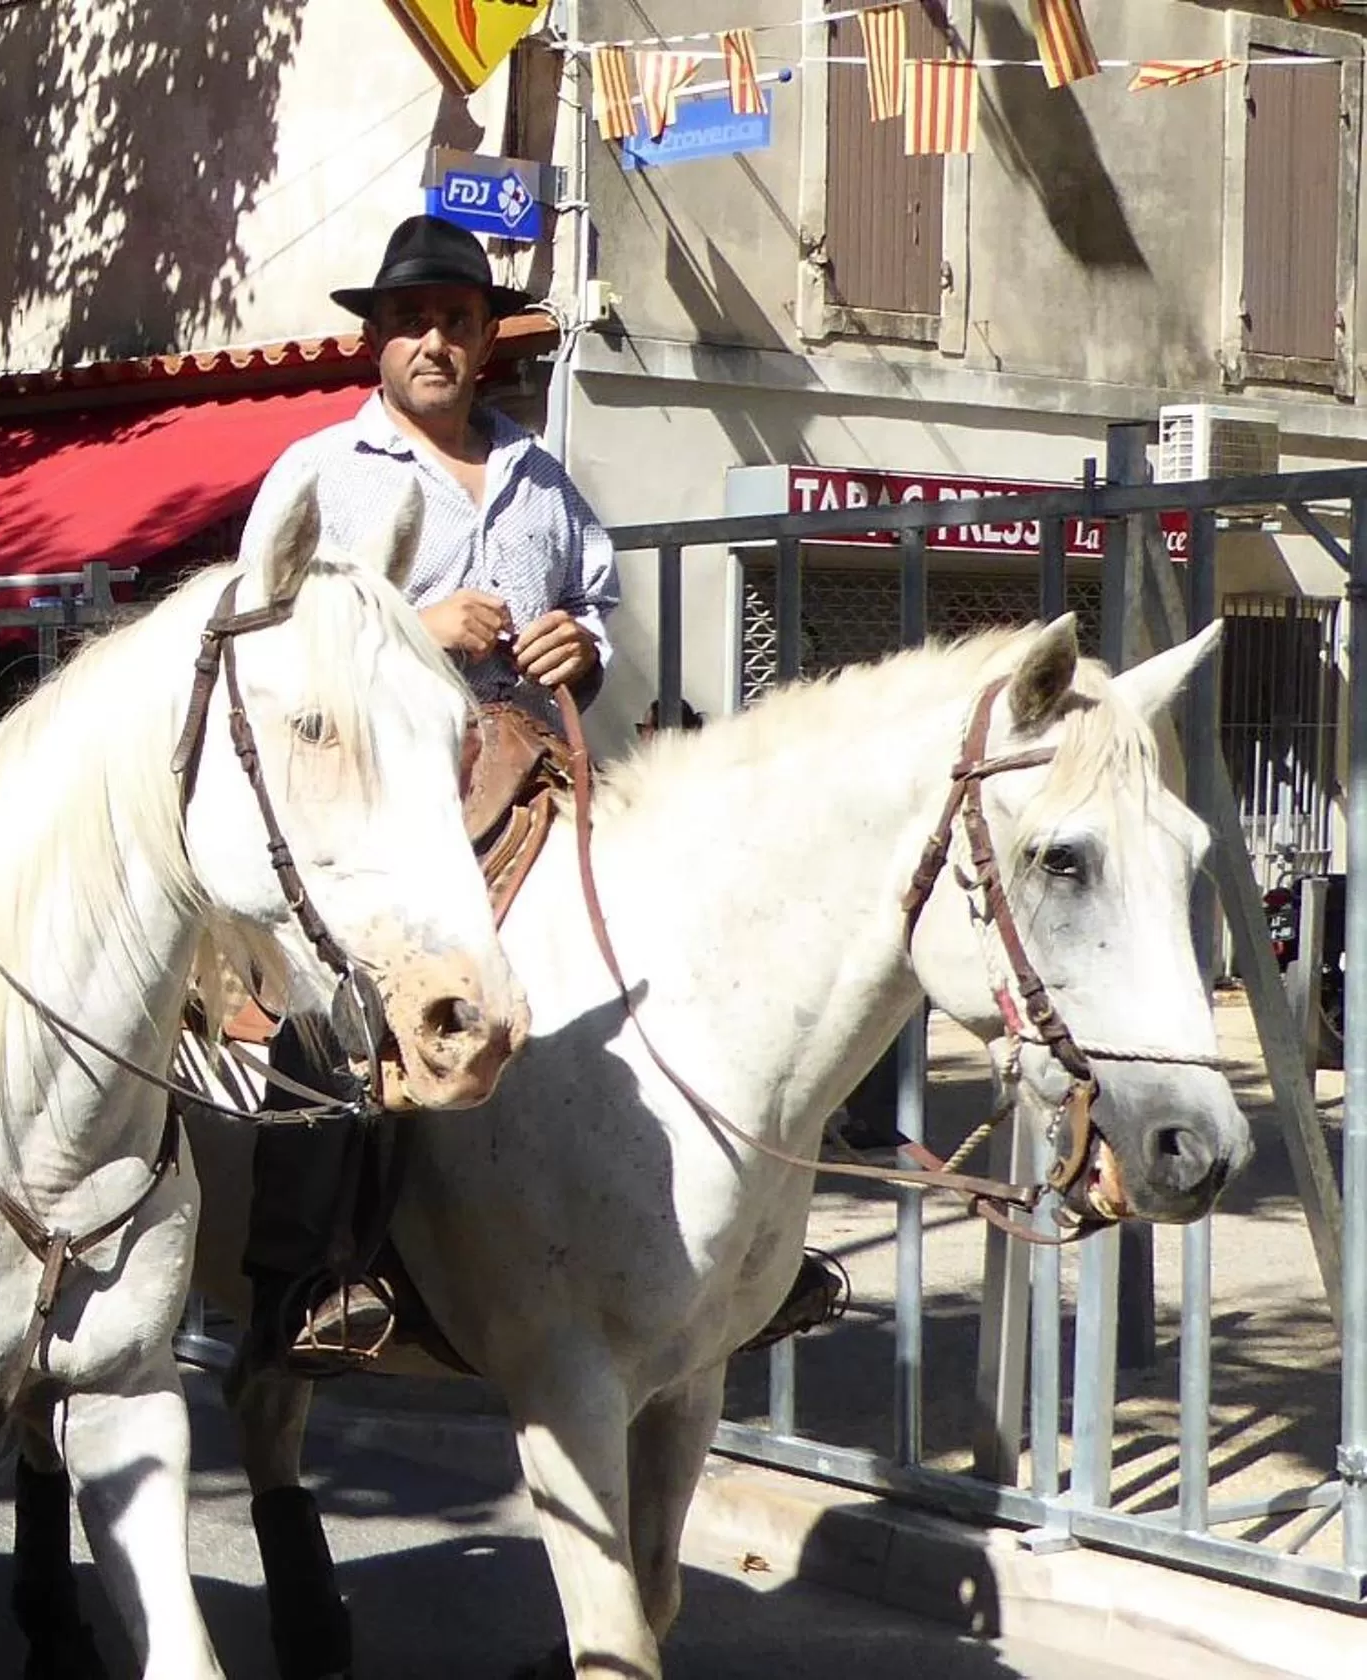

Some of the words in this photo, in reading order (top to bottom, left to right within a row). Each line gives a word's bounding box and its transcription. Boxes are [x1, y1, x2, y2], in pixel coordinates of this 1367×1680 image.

[662, 120, 762, 148] Provence
[447, 178, 491, 205] FDJ
[1075, 521, 1100, 549] La
